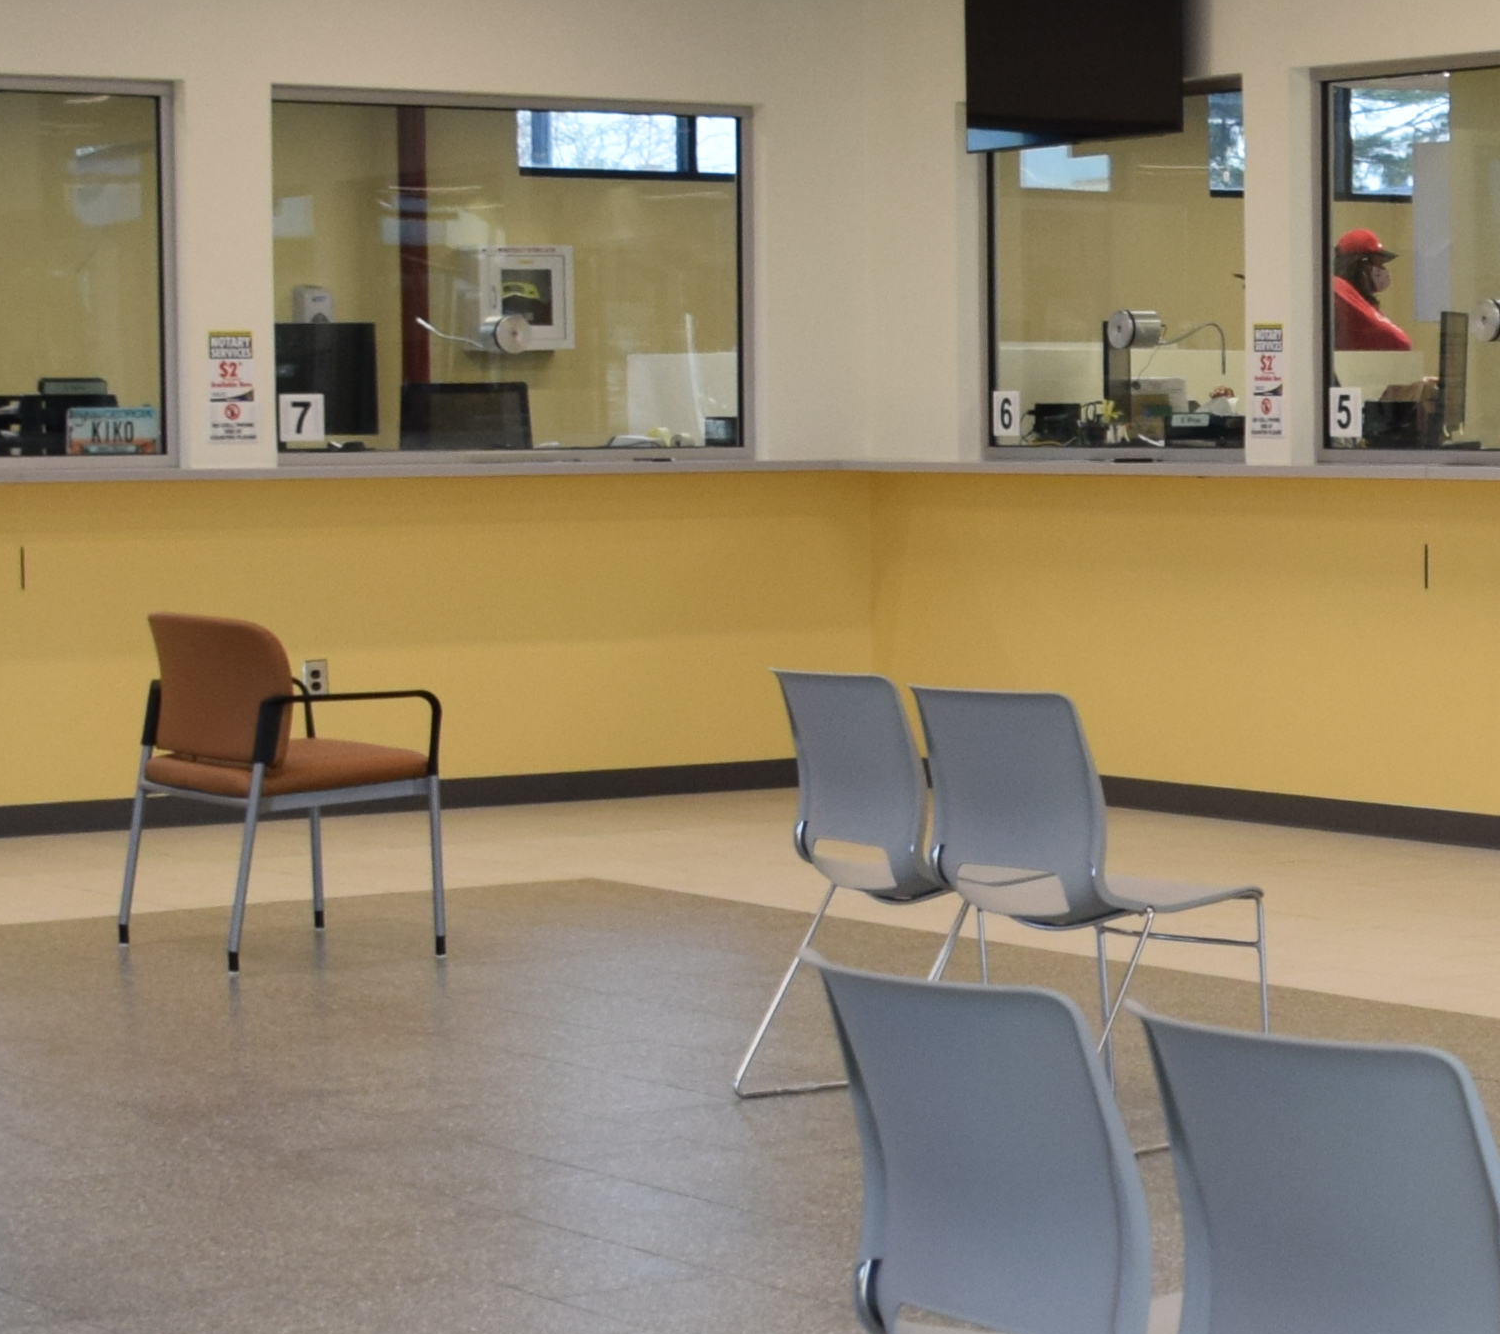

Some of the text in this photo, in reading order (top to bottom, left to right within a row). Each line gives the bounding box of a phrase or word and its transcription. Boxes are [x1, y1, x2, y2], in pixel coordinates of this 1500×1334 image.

[210, 337, 250, 348] NOTARY
[1255, 329, 1282, 341] NOTARY
[210, 348, 250, 358] SERVICES
[1255, 341, 1282, 351] SERVICES
[291, 401, 312, 435] 7
[1000, 397, 1013, 430] 6
[1336, 394, 1352, 430] 5
[91, 421, 135, 443] KIKO
